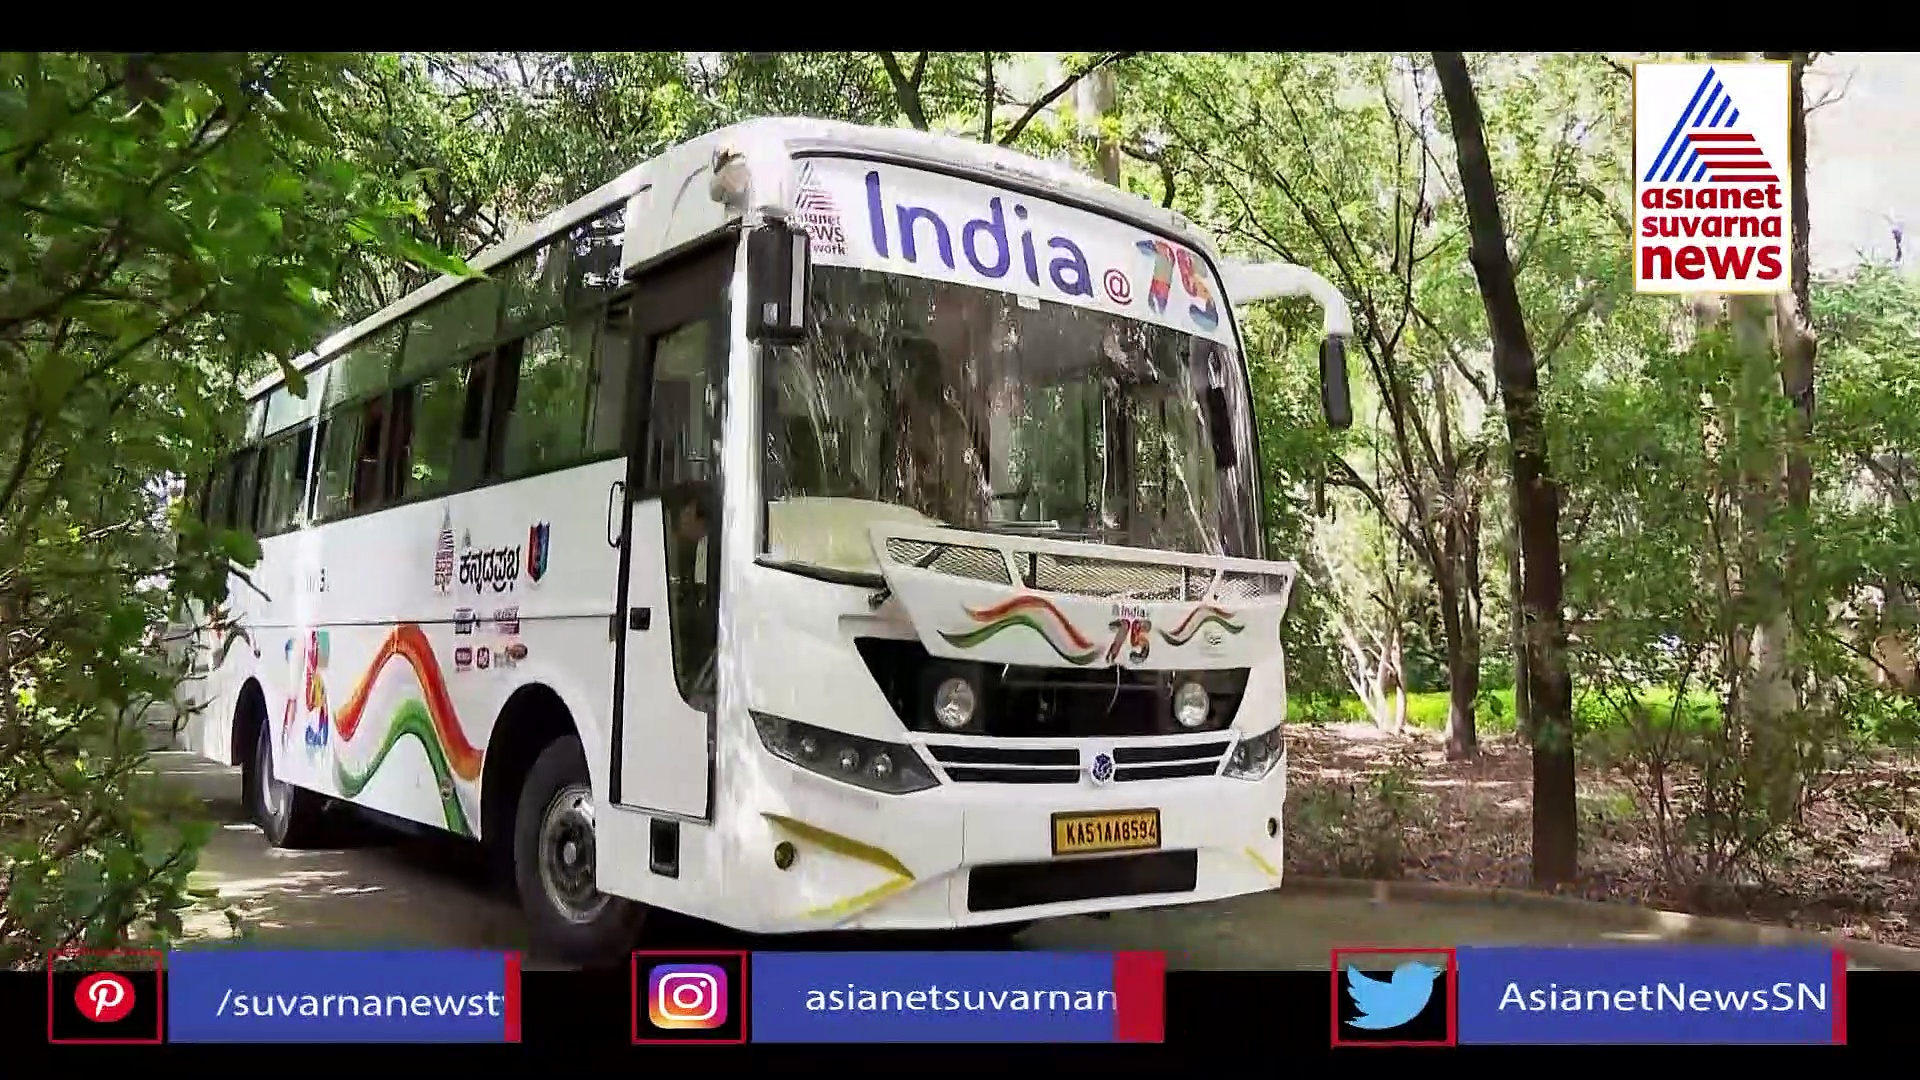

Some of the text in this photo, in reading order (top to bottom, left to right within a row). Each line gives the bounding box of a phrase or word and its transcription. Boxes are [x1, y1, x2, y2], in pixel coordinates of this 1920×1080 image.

[808, 225, 845, 243] ews
[864, 170, 1219, 331] India @ 75
[1105, 618, 1151, 663] 75
